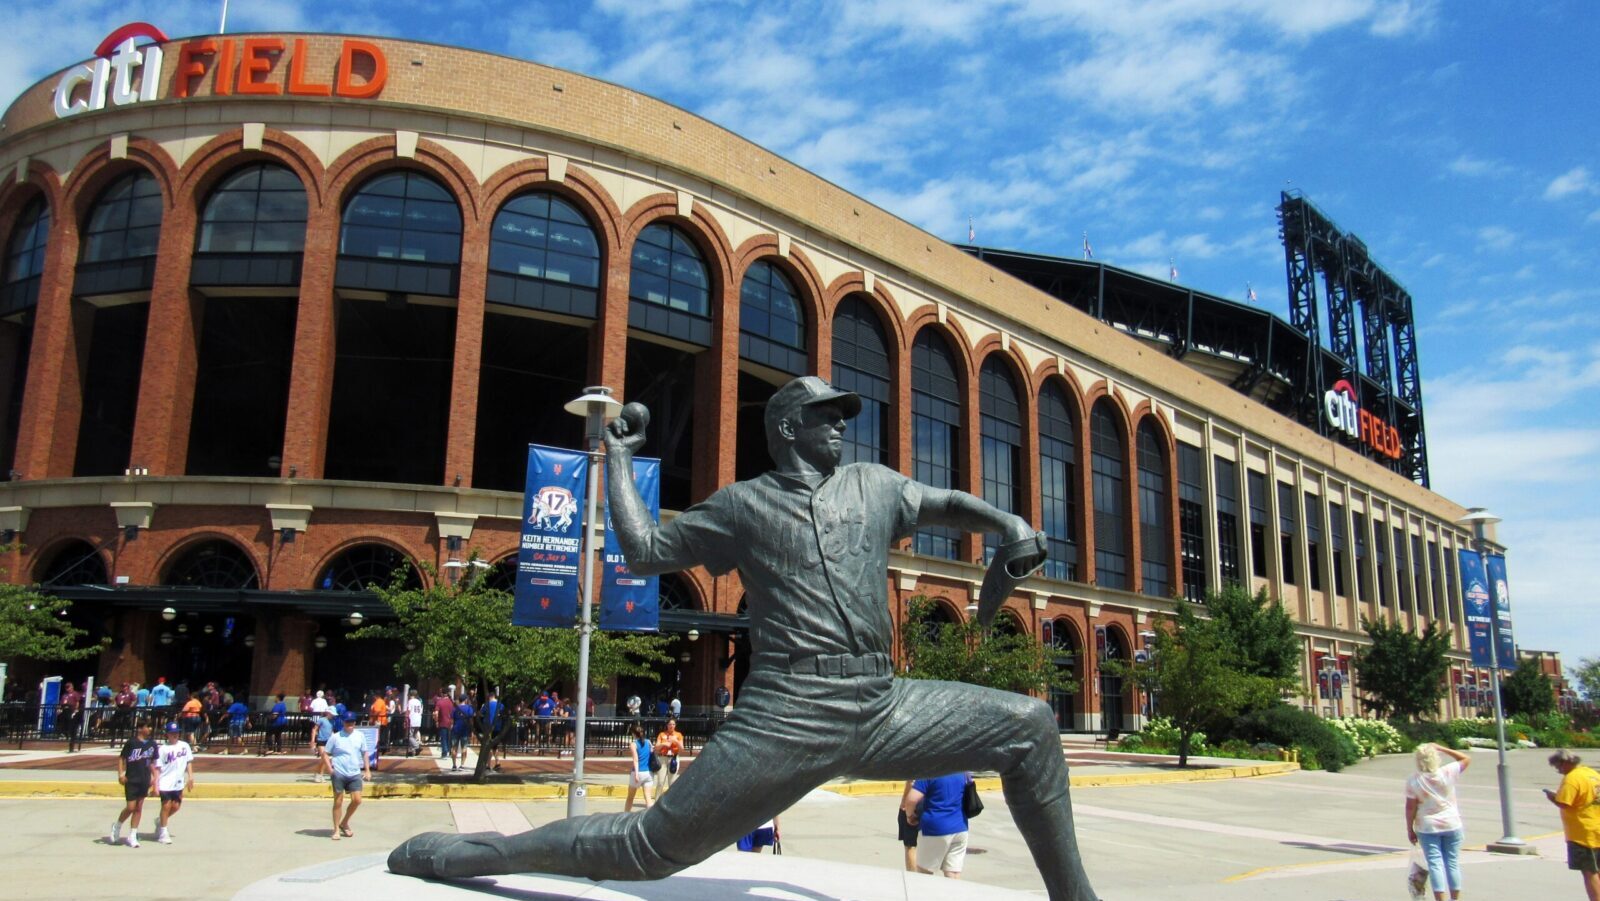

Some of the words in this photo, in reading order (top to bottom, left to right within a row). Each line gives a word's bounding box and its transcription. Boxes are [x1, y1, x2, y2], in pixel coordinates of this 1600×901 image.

[53, 36, 164, 118] citi
[174, 38, 389, 99] FIELD
[1325, 389, 1359, 438] citi
[1360, 408, 1401, 459] FIELD
[548, 494, 565, 511] 17
[522, 534, 541, 542] KEITH
[543, 536, 579, 546] HERNANDEZ
[546, 544, 578, 554] RETIREMENT
[560, 554, 567, 563] 9
[606, 554, 619, 563] OLD
[165, 747, 188, 764] Mets
